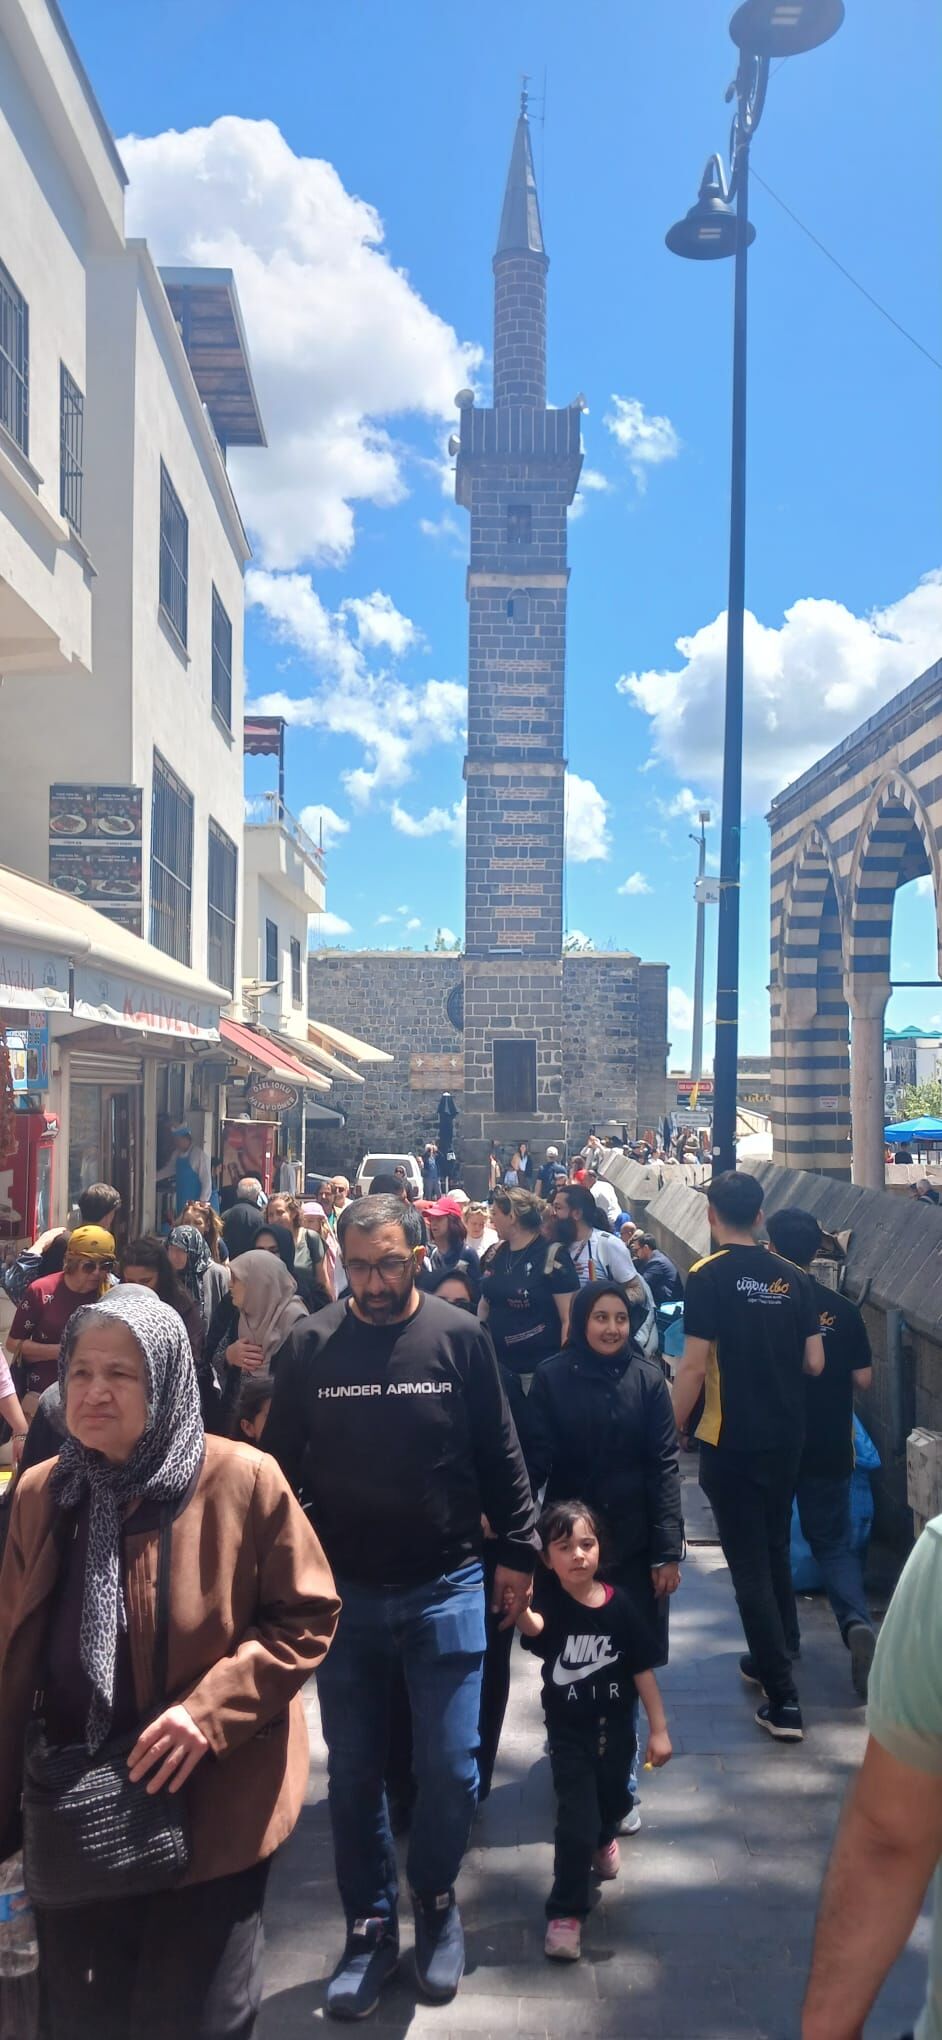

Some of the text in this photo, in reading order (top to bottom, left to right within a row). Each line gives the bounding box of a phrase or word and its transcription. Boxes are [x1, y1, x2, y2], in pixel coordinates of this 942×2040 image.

[248, 1096, 270, 1111] HATAY
[330, 1382, 453, 1398] UNDER ARMOUR
[562, 1634, 613, 1664] NIKE
[567, 1682, 620, 1701] AIR
